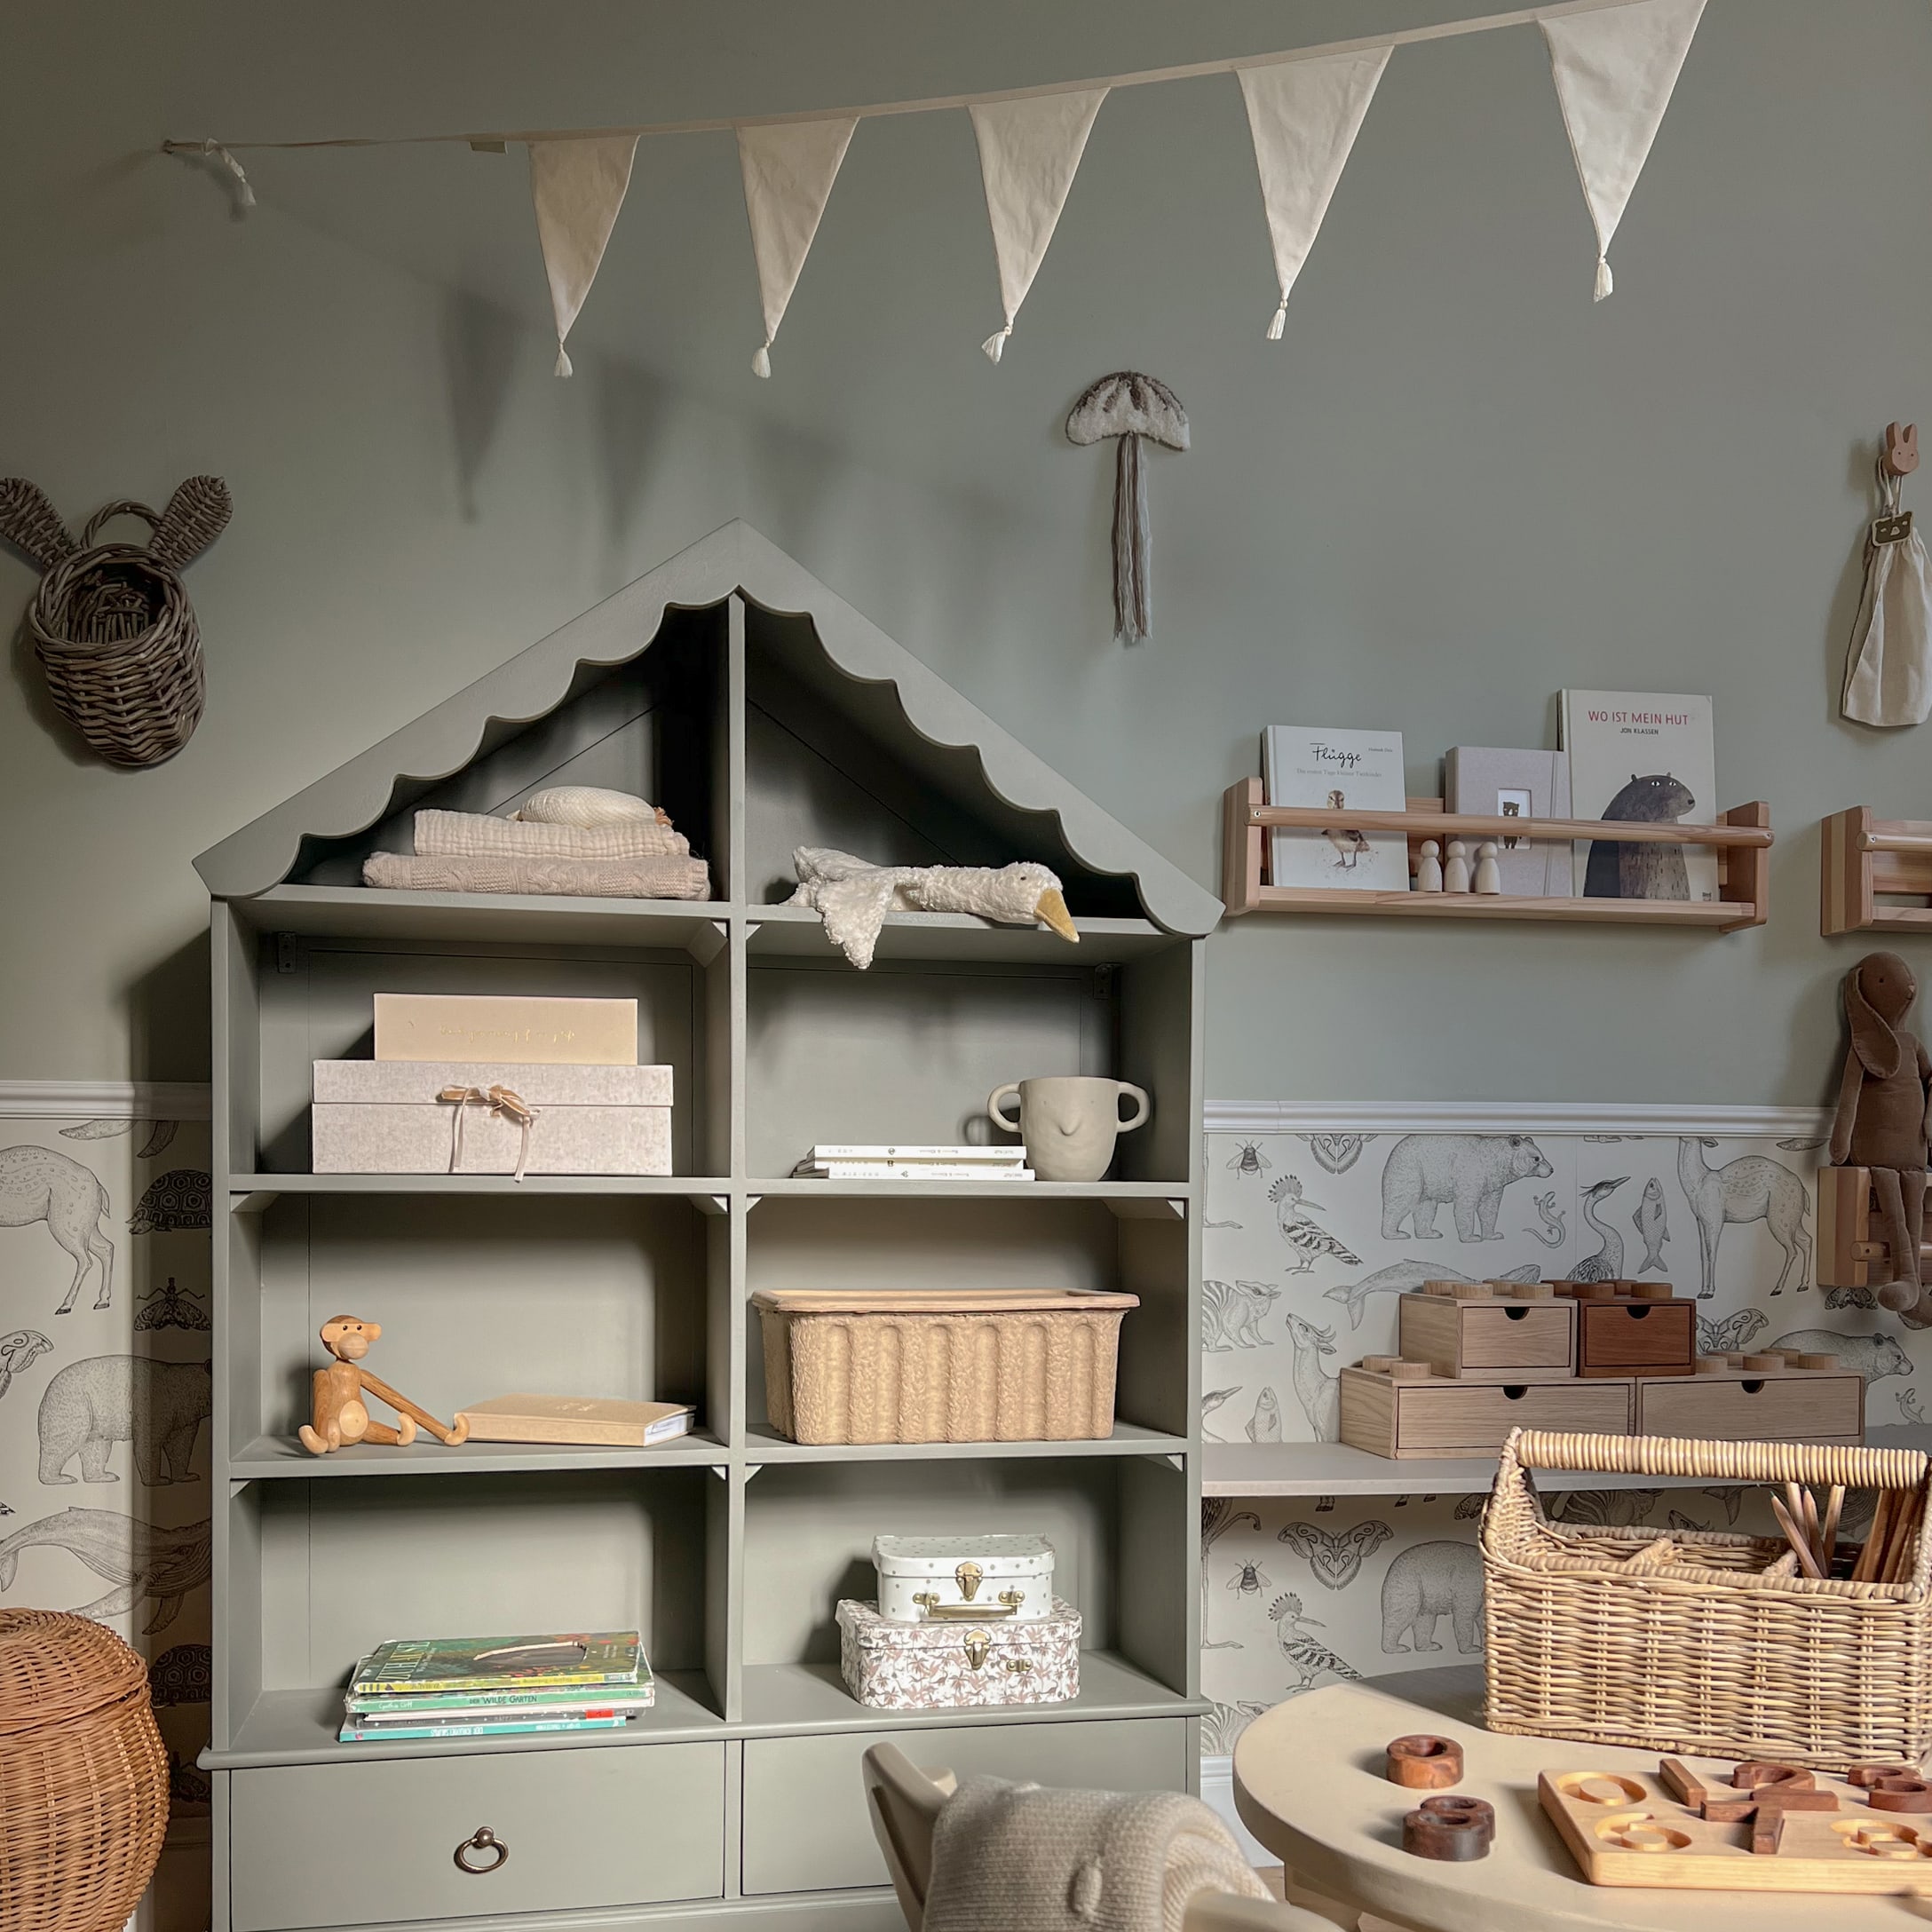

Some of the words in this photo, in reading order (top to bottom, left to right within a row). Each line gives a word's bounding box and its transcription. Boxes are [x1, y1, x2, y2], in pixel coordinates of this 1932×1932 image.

[1588, 710, 1609, 723] WO
[1611, 711, 1627, 724] IST
[1631, 712, 1662, 724] MEIN
[1666, 714, 1689, 725] HUT
[1310, 742, 1362, 769] Flügge
[482, 1696, 506, 1705] WILDE
[509, 1694, 537, 1704] GARTEN
